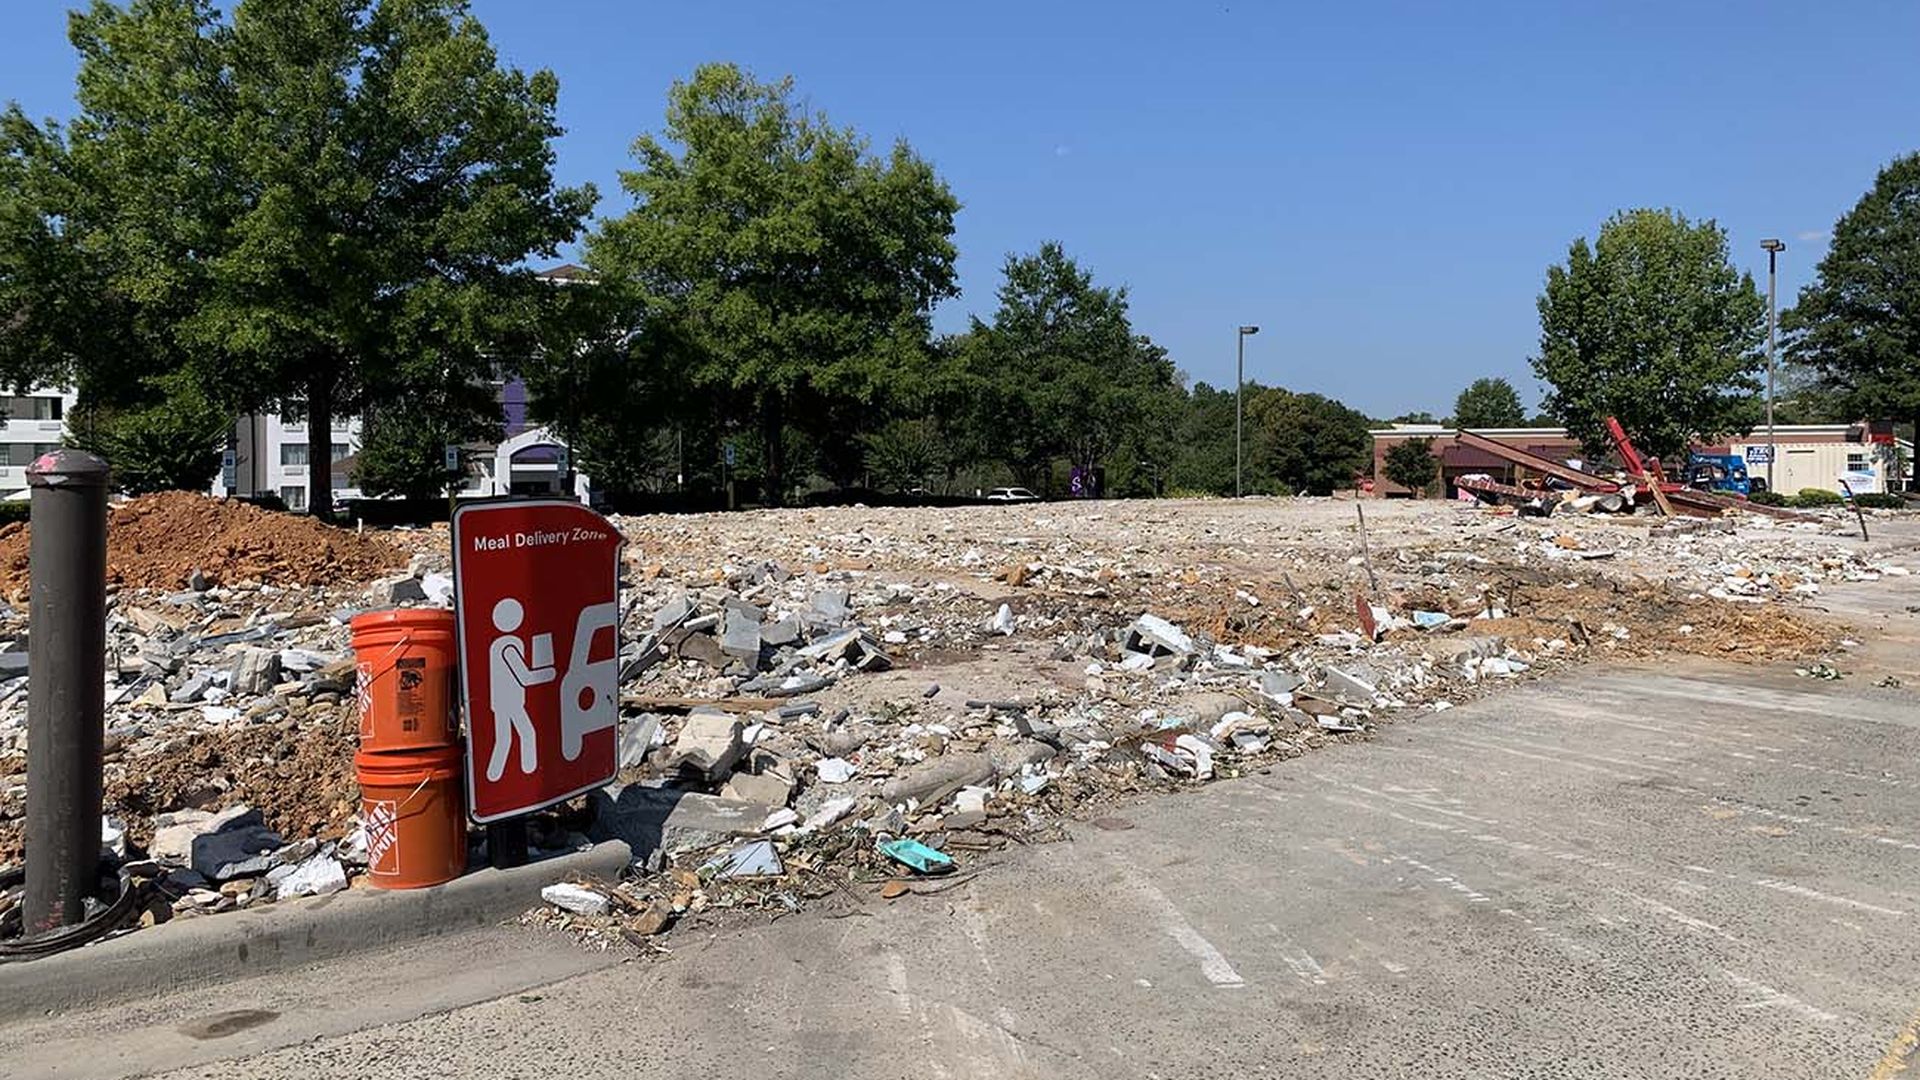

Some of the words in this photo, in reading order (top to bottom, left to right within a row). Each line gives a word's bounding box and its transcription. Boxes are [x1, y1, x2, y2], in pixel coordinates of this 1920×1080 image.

[474, 534, 510, 551] Meal
[515, 530, 570, 547] Delivery
[571, 527, 608, 541] Zone
